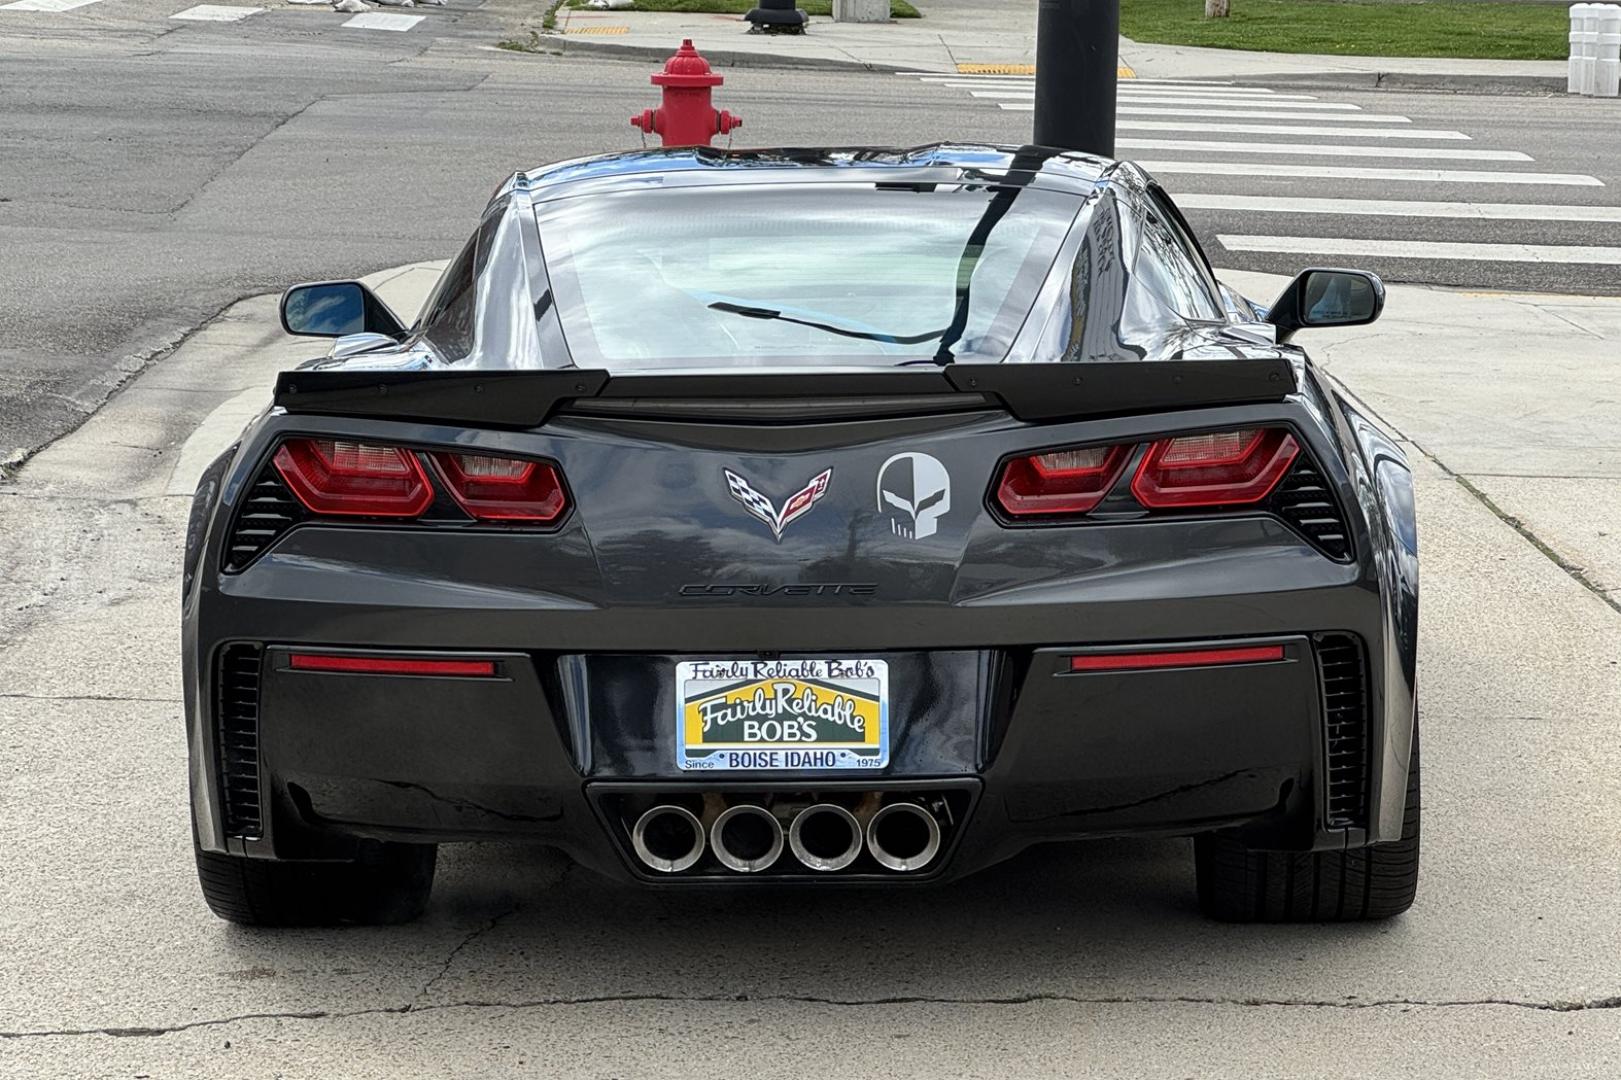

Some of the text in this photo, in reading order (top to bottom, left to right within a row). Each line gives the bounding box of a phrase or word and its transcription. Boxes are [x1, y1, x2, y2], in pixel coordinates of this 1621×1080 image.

[678, 583, 880, 596] CORVETTE
[689, 659, 875, 679] Fairly Reliable Bob's
[698, 682, 865, 732] Fairly Reliable
[743, 717, 818, 742] BOB'S
[685, 759, 714, 769] Since
[729, 751, 836, 768] BOISE IDAHO
[856, 758, 881, 767] 1975
